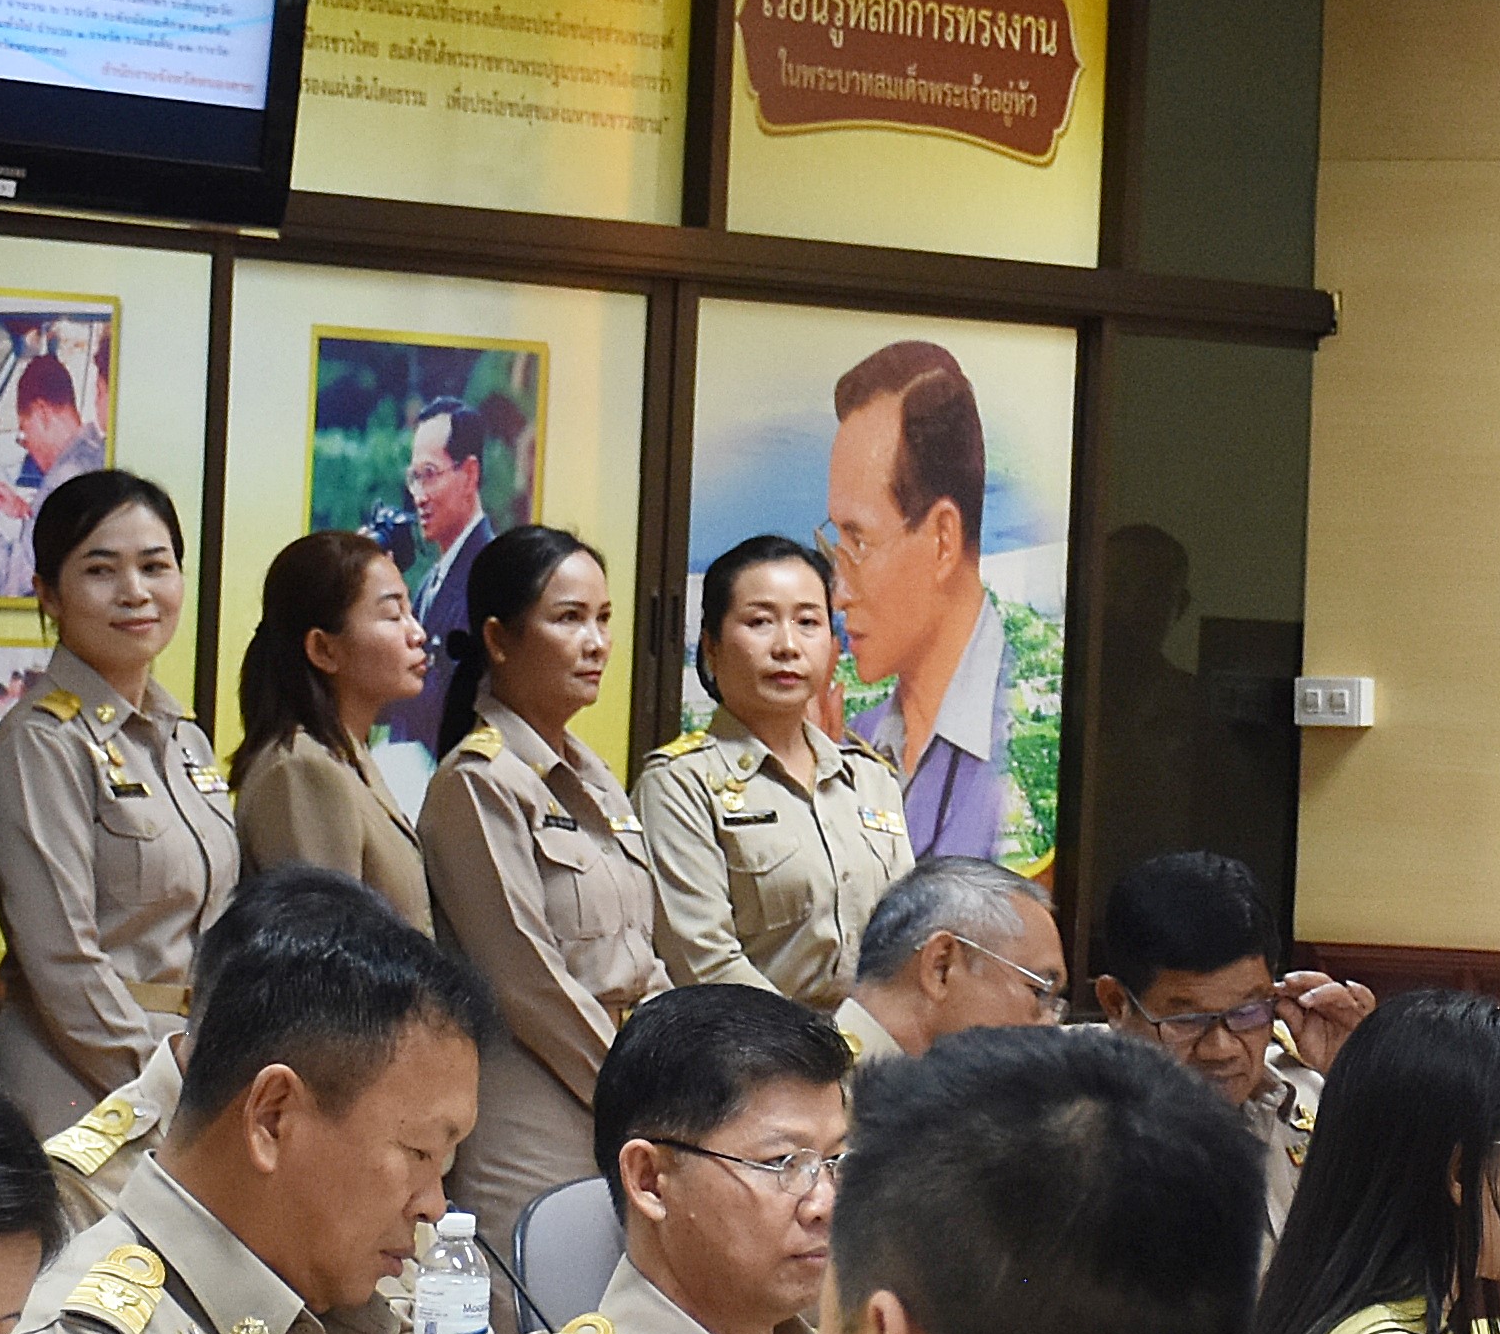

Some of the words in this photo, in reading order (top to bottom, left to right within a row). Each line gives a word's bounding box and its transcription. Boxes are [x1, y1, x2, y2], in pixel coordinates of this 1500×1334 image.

[777, 48, 1037, 128] ในพระบาทสมเด็จพระเจ้าอยู่หัว
